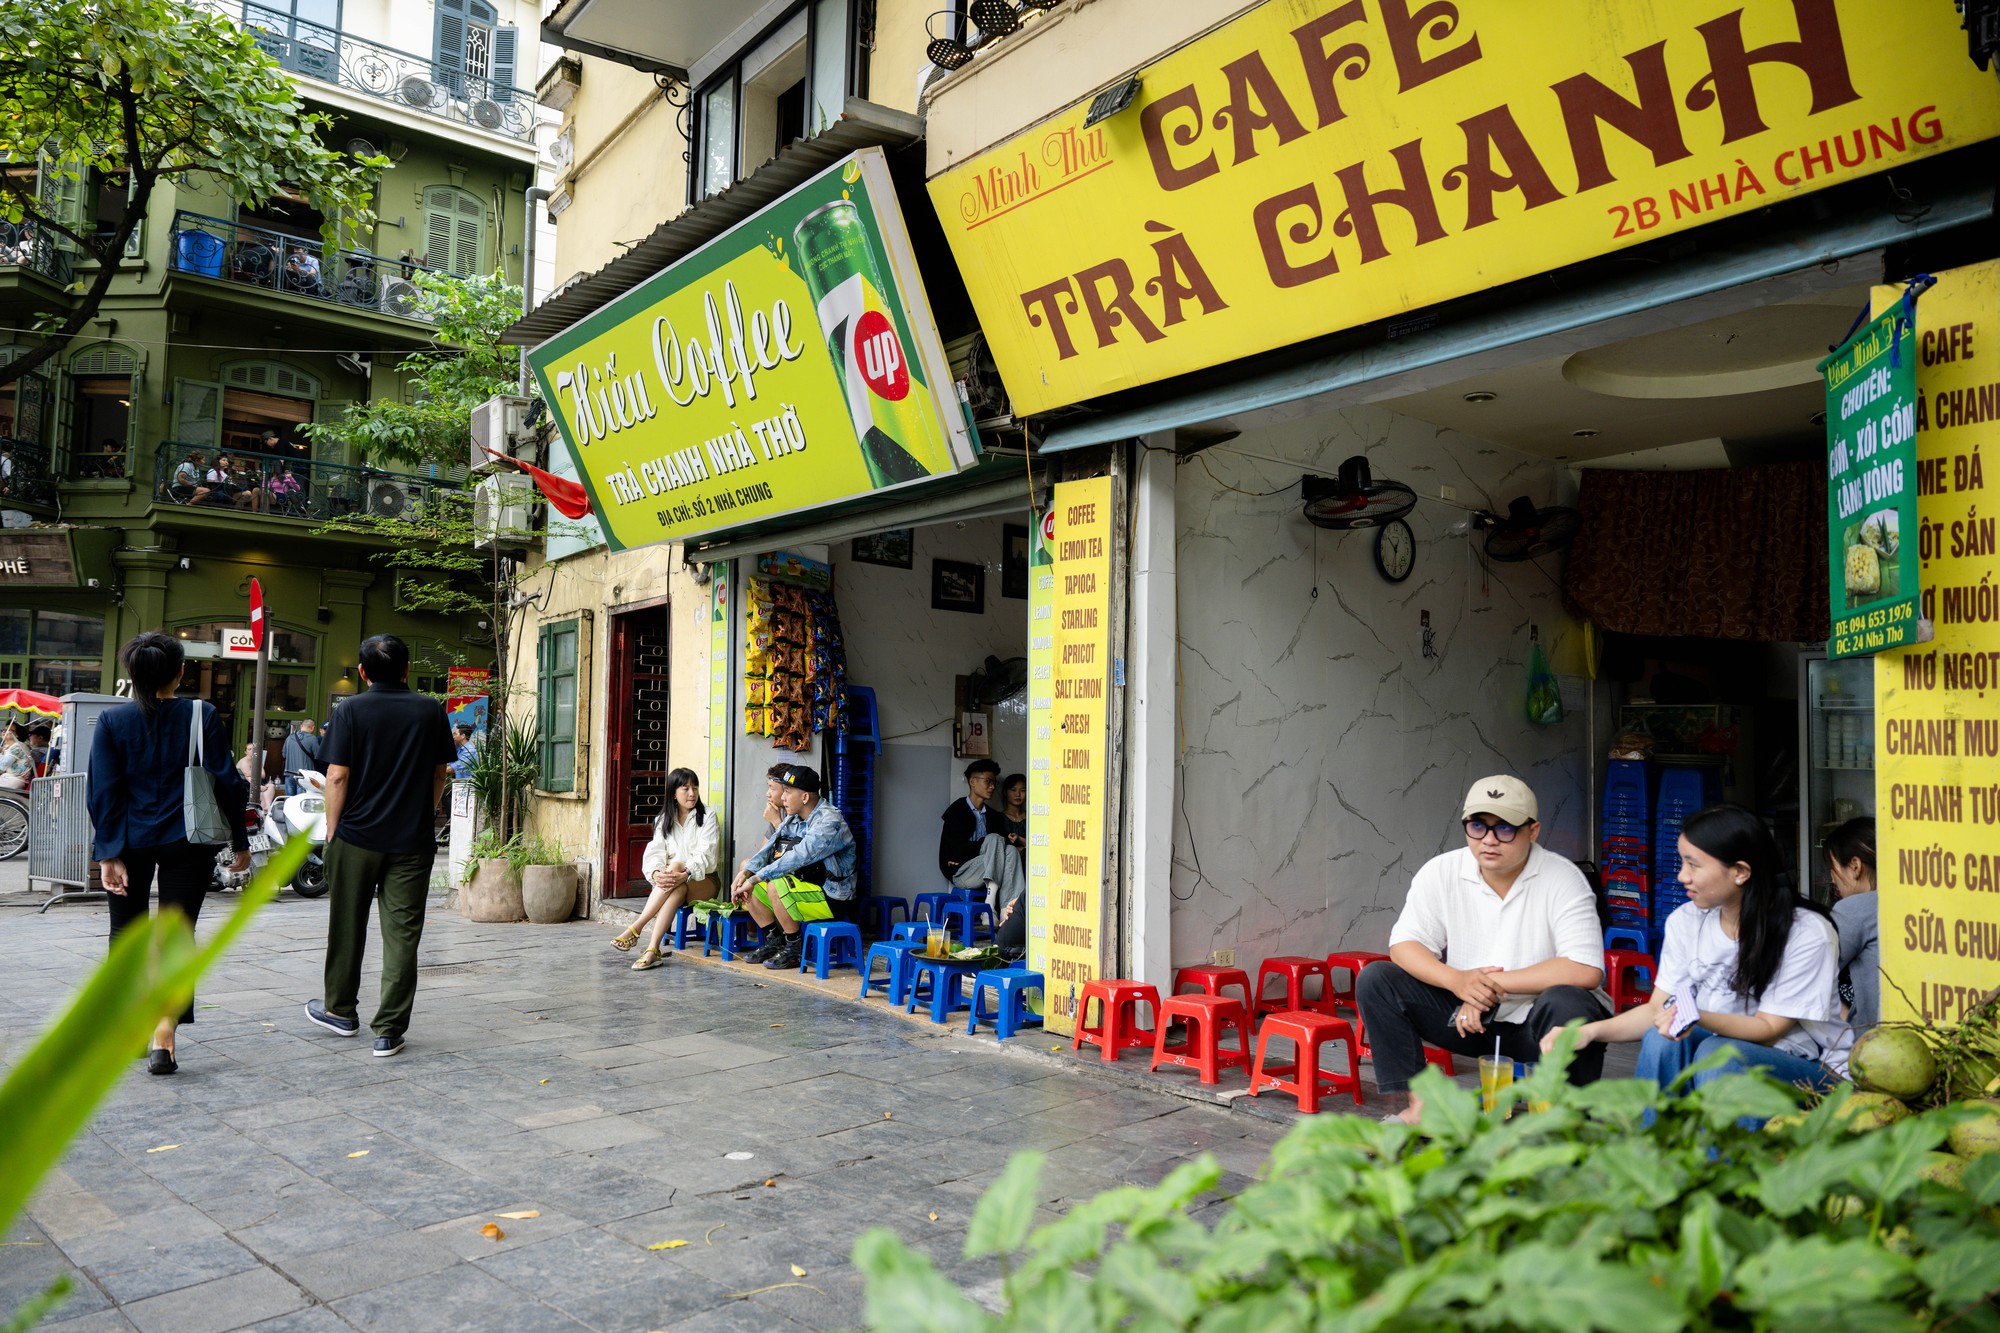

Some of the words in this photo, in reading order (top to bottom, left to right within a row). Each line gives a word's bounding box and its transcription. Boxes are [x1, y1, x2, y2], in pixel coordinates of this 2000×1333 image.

[960, 152, 1041, 225] Minh
[1041, 124, 1108, 178] Thu
[1020, 220, 1231, 361] TRÀ
[1252, 0, 1863, 289] CHANH
[1607, 196, 1661, 239] 2B
[1668, 158, 1766, 219] NHÀ
[1773, 105, 1944, 186] CHUNG
[556, 352, 657, 447] Hiếu
[651, 279, 804, 409] Coffee
[1922, 322, 1974, 367] CAFE
[1841, 366, 1891, 420] CHUYÊN:
[1856, 417, 1877, 462] XÔI
[1881, 395, 1914, 449] CỐM
[605, 461, 647, 506] TRÀ
[640, 446, 710, 497] CHANH
[704, 420, 758, 476] NHÀ
[754, 403, 807, 460] THỜ
[1917, 457, 1947, 496] ME
[1954, 444, 1984, 492] ĐÁ
[657, 508, 675, 529] ĐỊA
[673, 499, 694, 526] CHỈ:
[691, 494, 708, 518] SỐ
[706, 497, 716, 514] 2
[712, 488, 737, 513] NHÀ
[735, 481, 774, 506] CHUNG
[1838, 477, 1863, 520] LÀNG
[1863, 458, 1904, 505] VÒNG
[1067, 503, 1096, 527] COFFEE
[1059, 540, 1087, 562] LEMON
[1088, 537, 1103, 557] TEA
[1919, 516, 1944, 569] ỘT
[1951, 504, 1995, 559] SẮN
[1064, 573, 1096, 595] TAPIOCA
[1943, 570, 1999, 624] MUỐI
[1061, 608, 1098, 630] STARLING
[1850, 615, 1866, 633] 094
[1868, 609, 1886, 629] 653
[1888, 601, 1912, 623] 1976
[1062, 643, 1095, 664] APRICOT
[1852, 634, 1864, 652] 24
[1866, 630, 1884, 648] Nhà
[1886, 625, 1904, 644] Thờ
[1055, 679, 1073, 699] SALT
[1074, 678, 1102, 699] LEMON
[1904, 649, 1936, 691] MƠ
[1943, 652, 2000, 699] NGỌT
[1064, 714, 1090, 734] SRESH
[1886, 718, 1957, 756] CHANH
[1964, 719, 1998, 757] MU
[1063, 749, 1090, 769] LEMON
[1060, 784, 1091, 805] ORANGE
[1891, 783, 1962, 823] CHANH
[1063, 820, 1086, 841] JUICE
[1060, 854, 1089, 877] YAGURT
[1899, 843, 1957, 889] NƯỚC
[1060, 891, 1087, 912] LIPTON
[1053, 923, 1092, 949] SMOOTHIE
[1904, 908, 1947, 955] SỮA
[1955, 919, 2000, 962] CHU
[1051, 958, 1076, 982] PEACH
[1078, 963, 1092, 985] TEA
[1921, 982, 1995, 1027] LIPTO
[1173, 1056, 1186, 1066] 24
